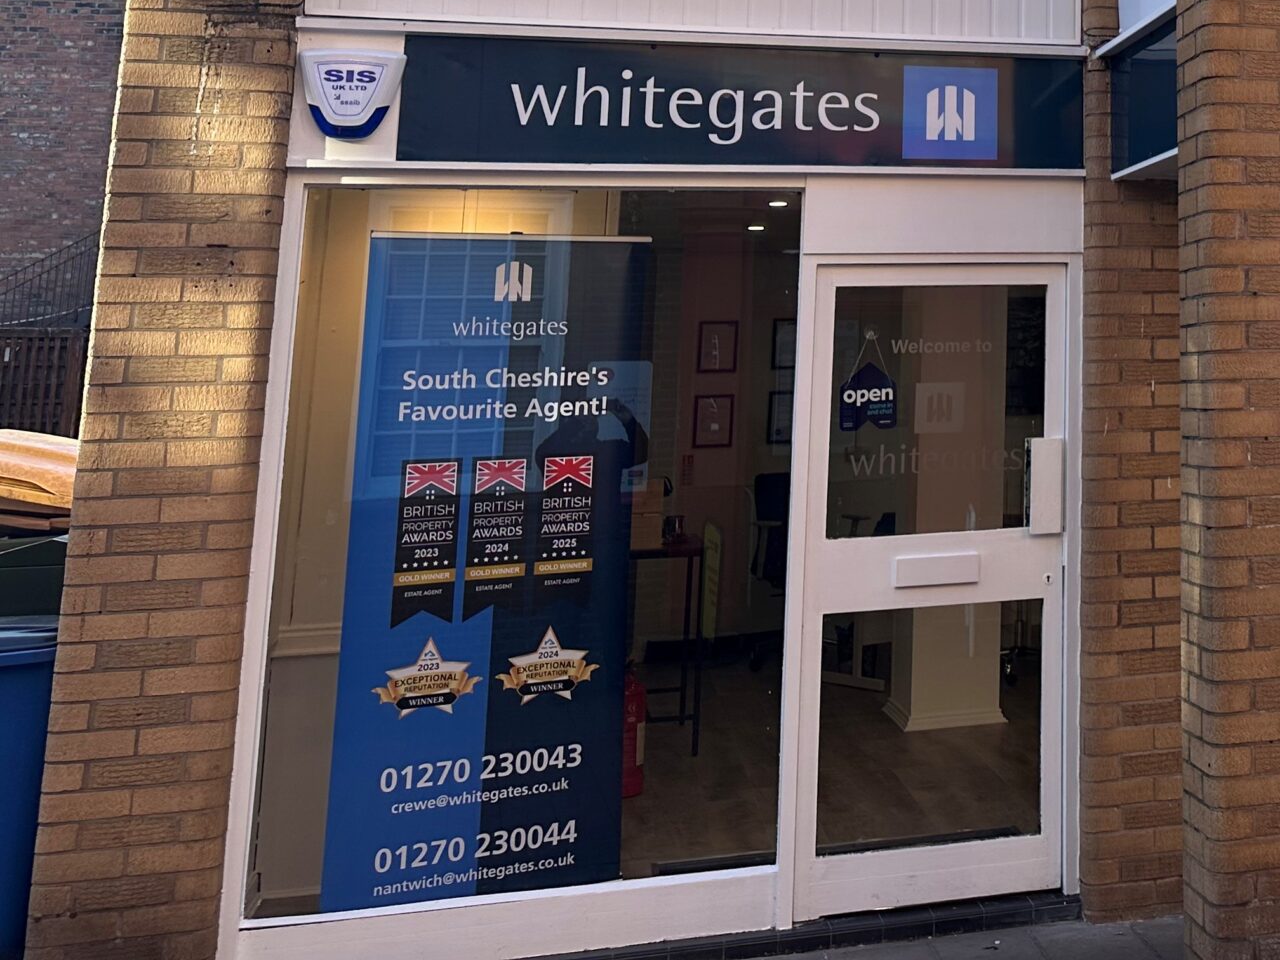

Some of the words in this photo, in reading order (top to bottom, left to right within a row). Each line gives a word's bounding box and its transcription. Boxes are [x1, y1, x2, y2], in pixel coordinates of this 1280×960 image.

[323, 69, 377, 84] SIS
[510, 66, 881, 145] whitegates
[452, 316, 569, 340] whitegates
[891, 338, 971, 355] Welcome
[976, 339, 993, 353] to
[402, 368, 477, 390] South
[485, 366, 609, 387] Cheshire's
[842, 387, 894, 407] open
[398, 398, 517, 422] Favourite
[524, 395, 608, 422] Agent!
[474, 500, 525, 513] BRITISH
[542, 496, 592, 509] BRITISH
[403, 503, 455, 518] BRITISH
[473, 516, 524, 527] PROPERTY
[541, 512, 591, 523] PROPERTY
[402, 520, 454, 531] PROPERTY
[540, 521, 590, 534] AWARDS
[401, 530, 453, 544] AWARDS
[472, 526, 523, 539] AWARDS
[485, 543, 509, 553] 2024
[552, 538, 577, 549] 2025
[414, 547, 439, 558] 2023
[470, 568, 491, 577] GOLD
[491, 566, 520, 575] WINNER
[538, 563, 559, 572] GOLD
[560, 561, 588, 570] WINNER
[398, 574, 420, 583] GOLD
[421, 572, 450, 581] WINNER
[562, 577, 581, 585] AGENT
[404, 590, 423, 598] ESTATE
[423, 588, 443, 596] AGENT
[475, 584, 494, 592] ESTATE
[494, 582, 513, 590] AGENT
[537, 650, 559, 659] 2024
[417, 662, 440, 672] 2023
[516, 660, 577, 675] EXCEPTIONAL
[394, 673, 459, 688] EXCEPTIONAL
[525, 669, 569, 679] REPUTATION
[403, 681, 450, 693] REPUTATION
[530, 682, 564, 692] WINNER
[409, 696, 444, 706] WINNER
[379, 758, 471, 793] 01270
[479, 743, 583, 781] 230043
[391, 777, 570, 814] crewe@whitegates.co.uk
[374, 836, 466, 874] 01270
[474, 819, 578, 859] 230044
[373, 852, 576, 897] nantwich@whitegates.co.uk
